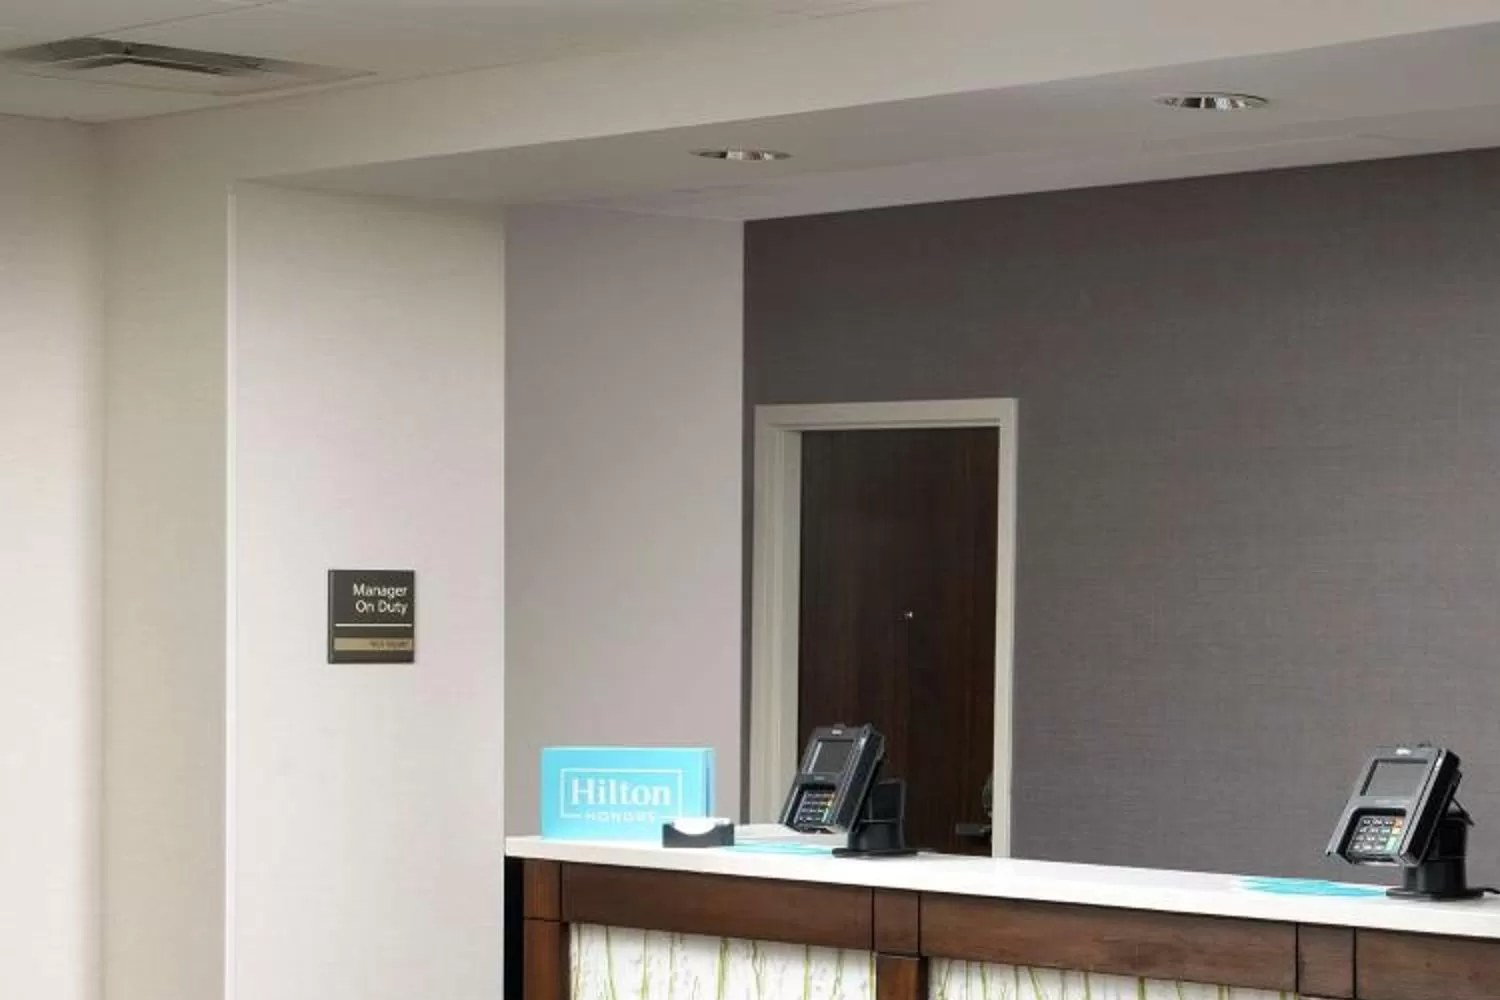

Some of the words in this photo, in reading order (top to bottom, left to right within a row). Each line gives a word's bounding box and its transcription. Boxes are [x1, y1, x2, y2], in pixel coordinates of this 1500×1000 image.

[352, 583, 408, 599] Manager
[355, 599, 375, 613] On
[378, 600, 408, 616] Duty
[570, 776, 672, 806] Hilton
